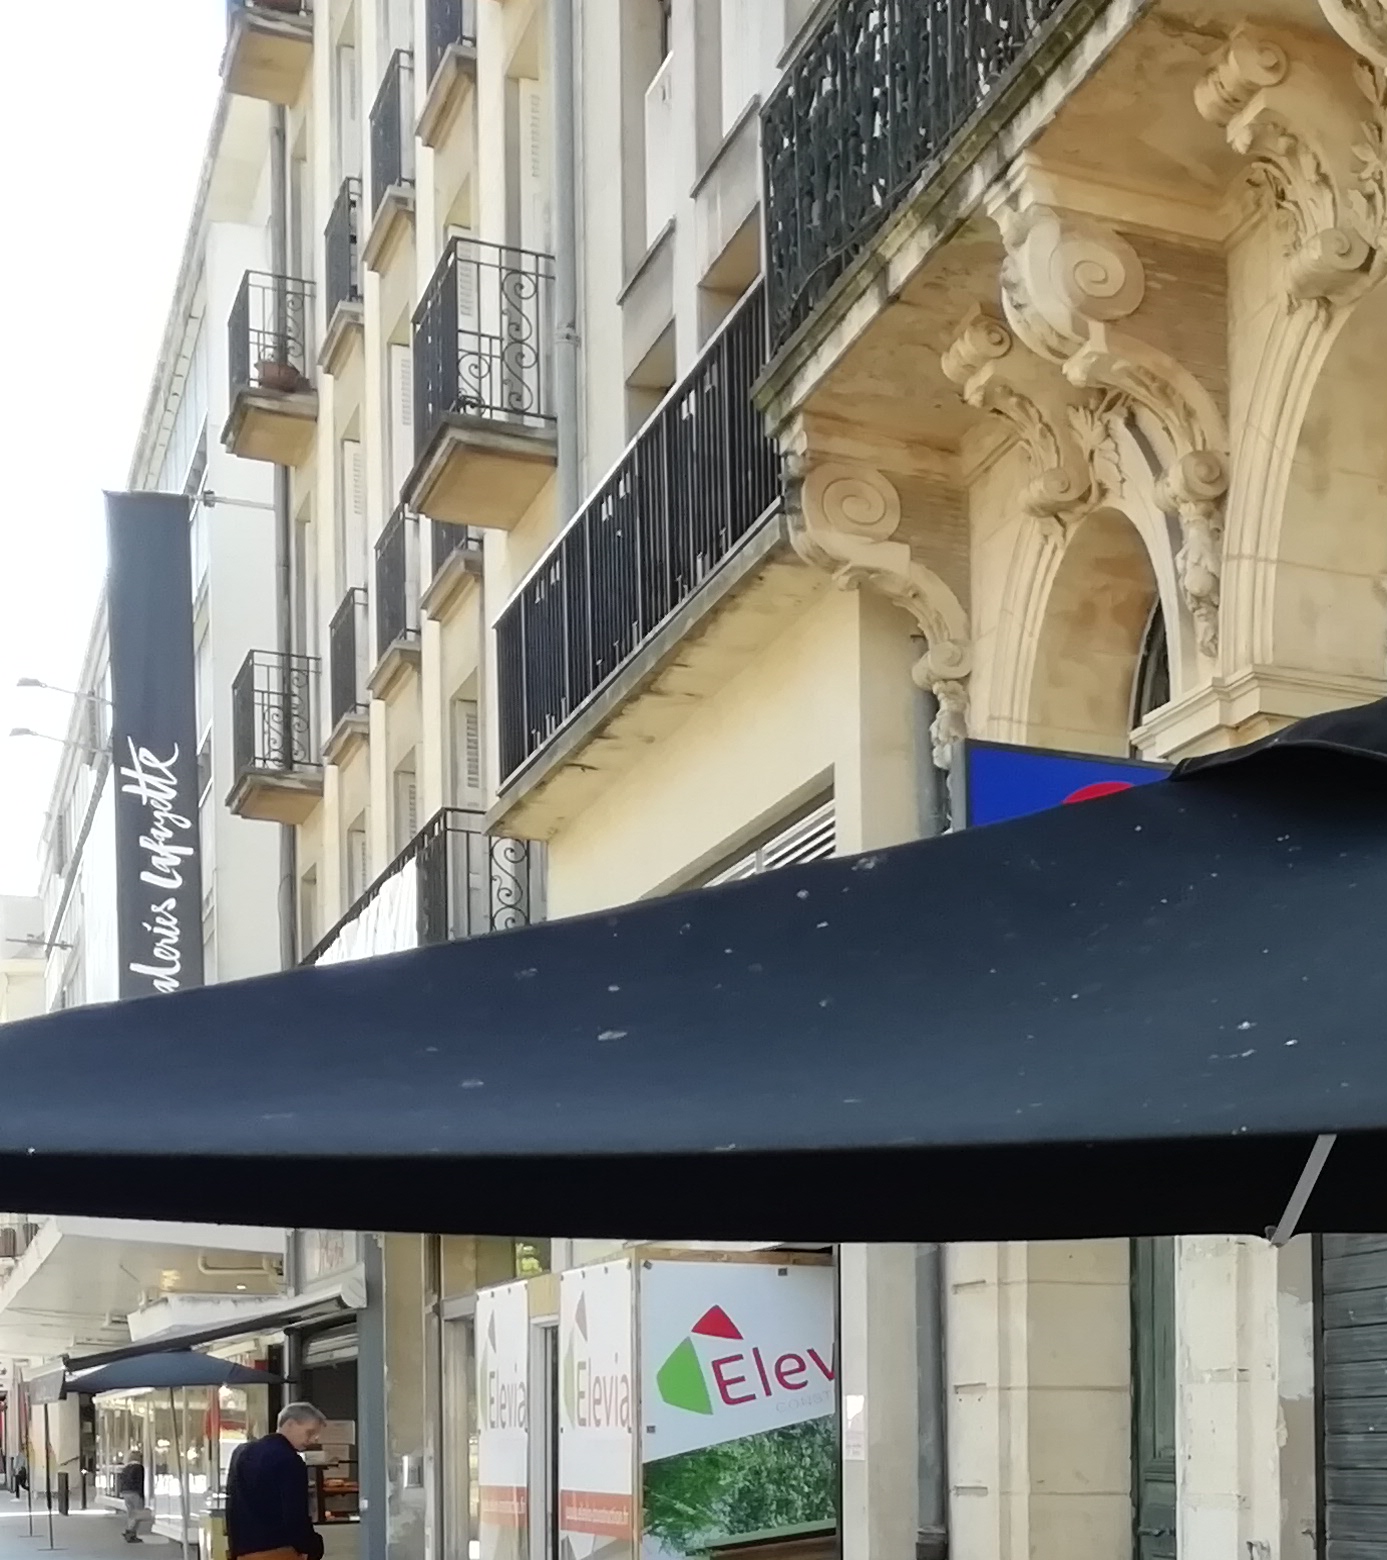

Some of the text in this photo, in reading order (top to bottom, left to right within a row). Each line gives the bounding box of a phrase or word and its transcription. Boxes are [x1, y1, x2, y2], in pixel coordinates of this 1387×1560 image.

[119, 735, 195, 889] Lafayette
[488, 1361, 528, 1430] Elevia
[575, 1352, 631, 1430] Elevia
